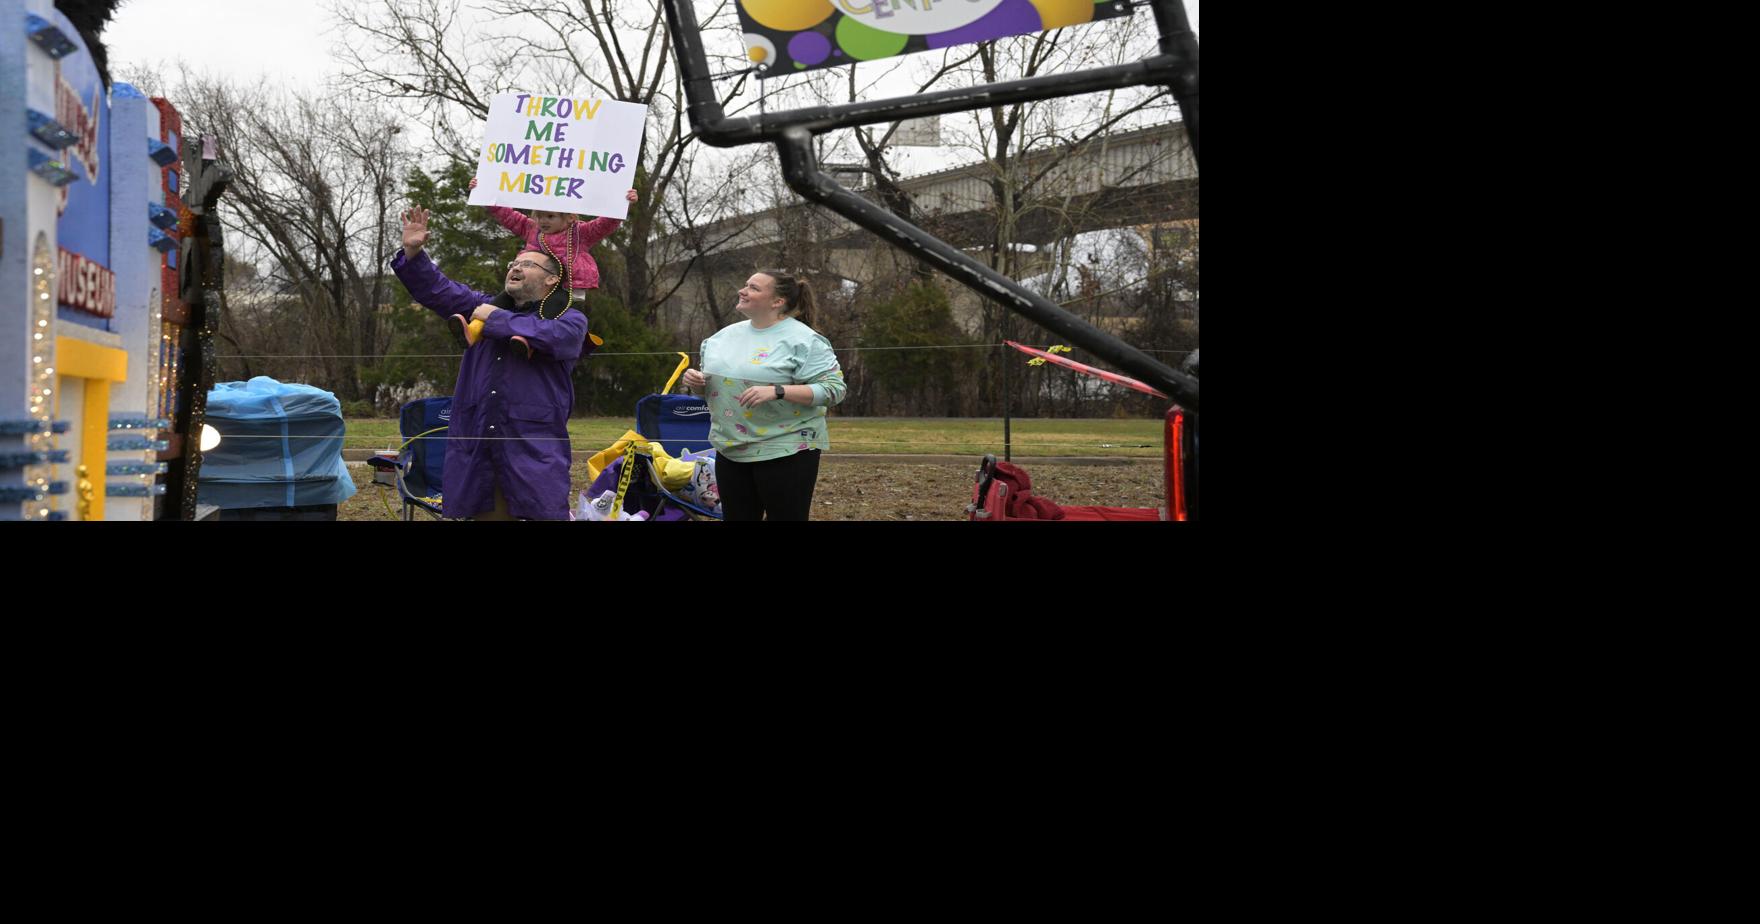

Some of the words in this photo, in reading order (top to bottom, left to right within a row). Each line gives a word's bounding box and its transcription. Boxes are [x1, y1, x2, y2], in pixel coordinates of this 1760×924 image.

[515, 94, 602, 121] THROW
[524, 120, 568, 142] ME
[487, 143, 626, 173] SOMETHING
[499, 171, 585, 199] MISTER
